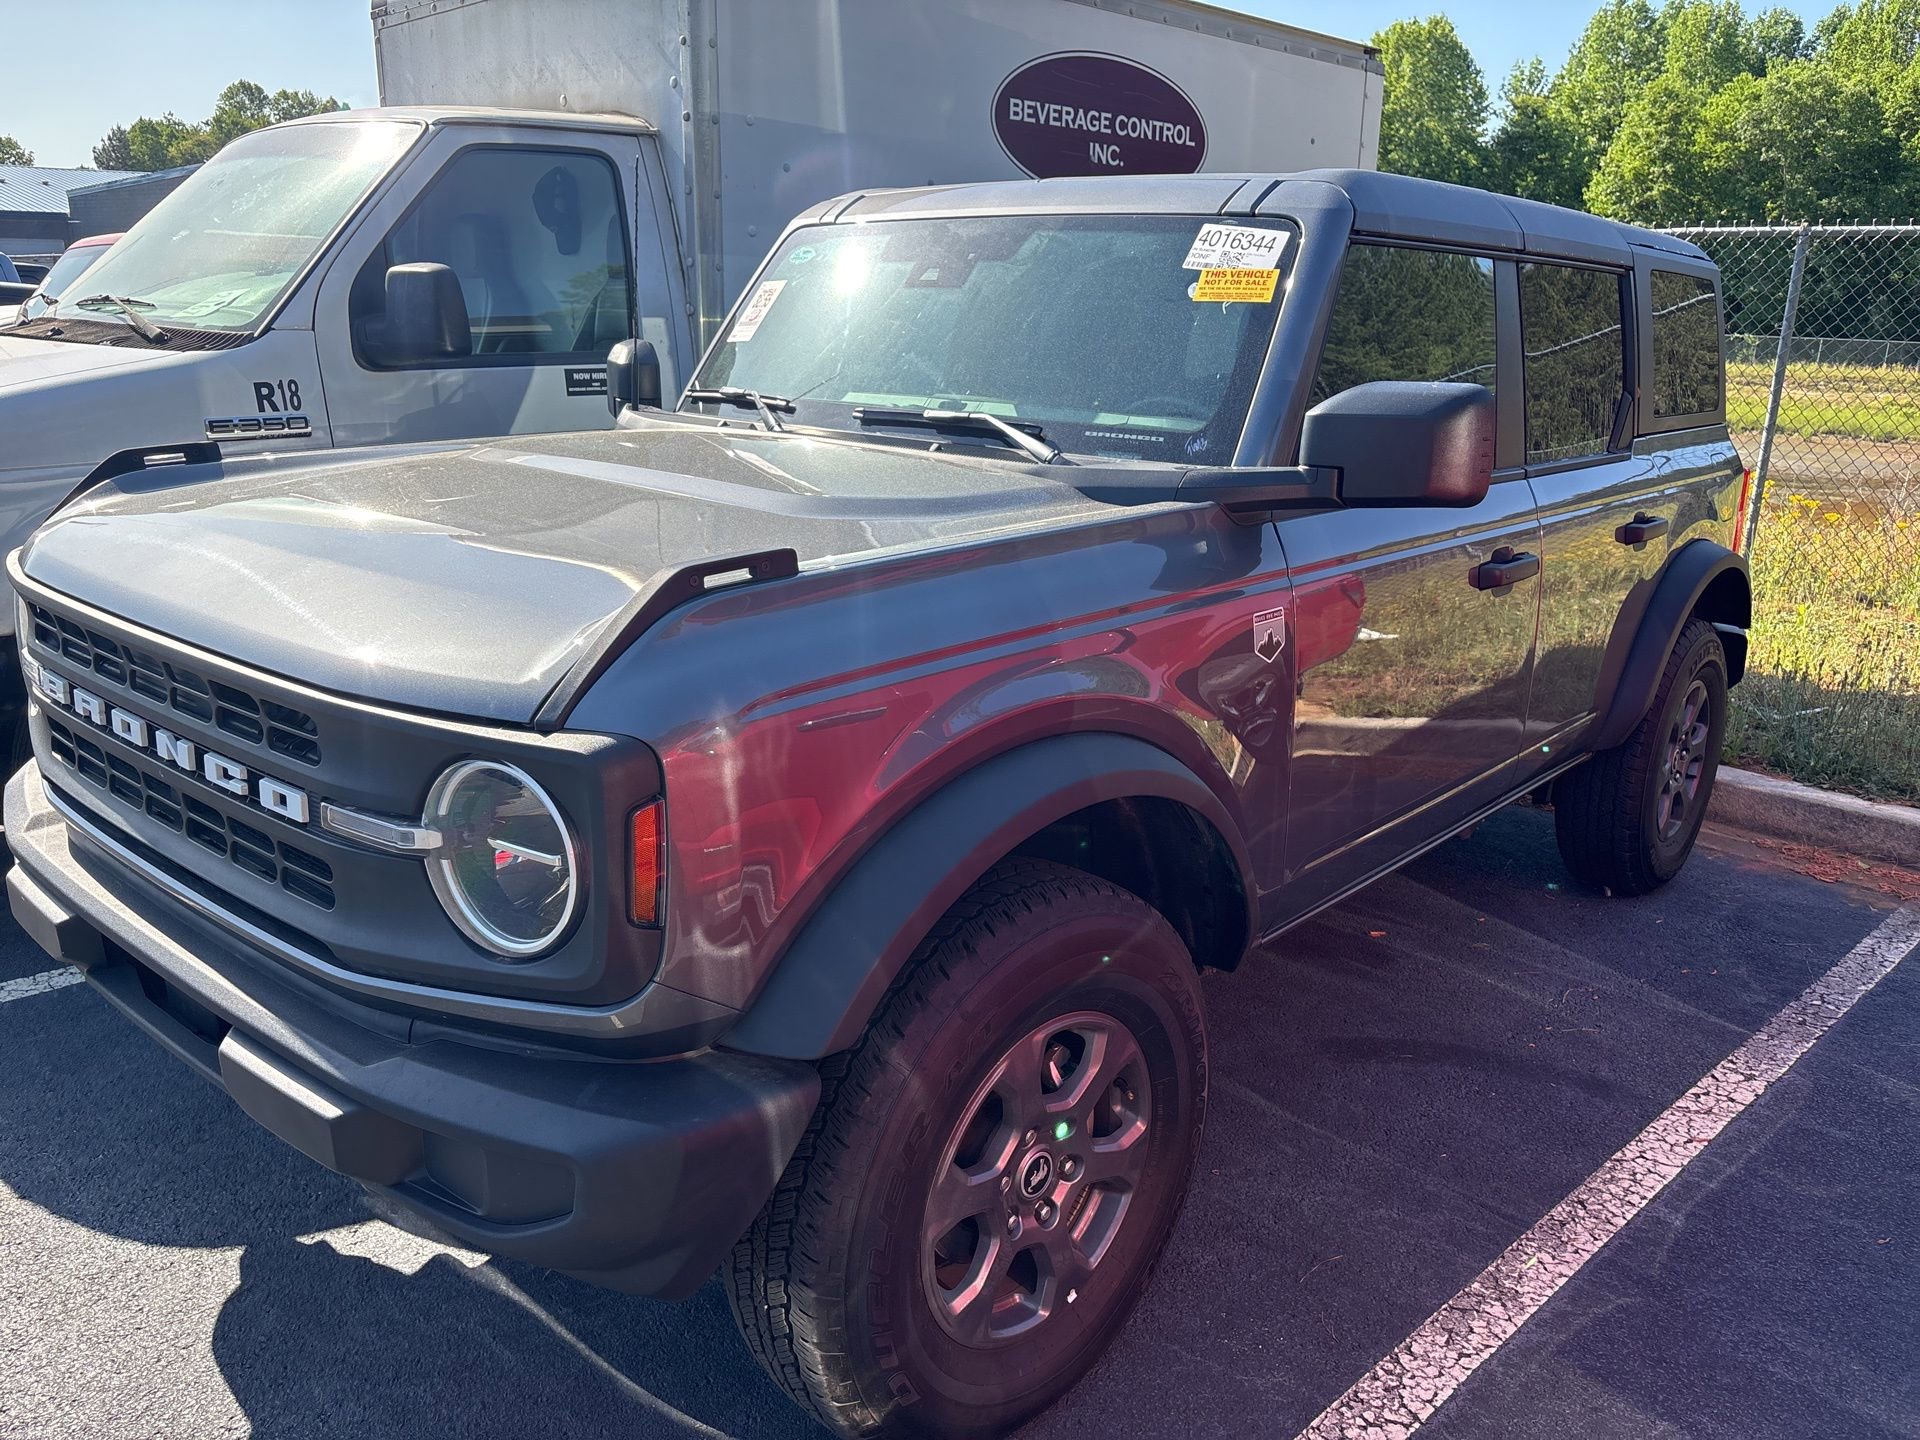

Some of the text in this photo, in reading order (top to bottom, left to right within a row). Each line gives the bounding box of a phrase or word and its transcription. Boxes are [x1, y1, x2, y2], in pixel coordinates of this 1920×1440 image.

[1009, 97, 1196, 147] BEVERAGE CONTROL
[1089, 142, 1125, 167] INC.
[1198, 230, 1277, 253] 4016344
[1205, 270, 1273, 279] THIS VEHICLE
[253, 379, 302, 413] R18
[1084, 431, 1164, 442] BRONCO
[40, 668, 310, 823] BRONCO
